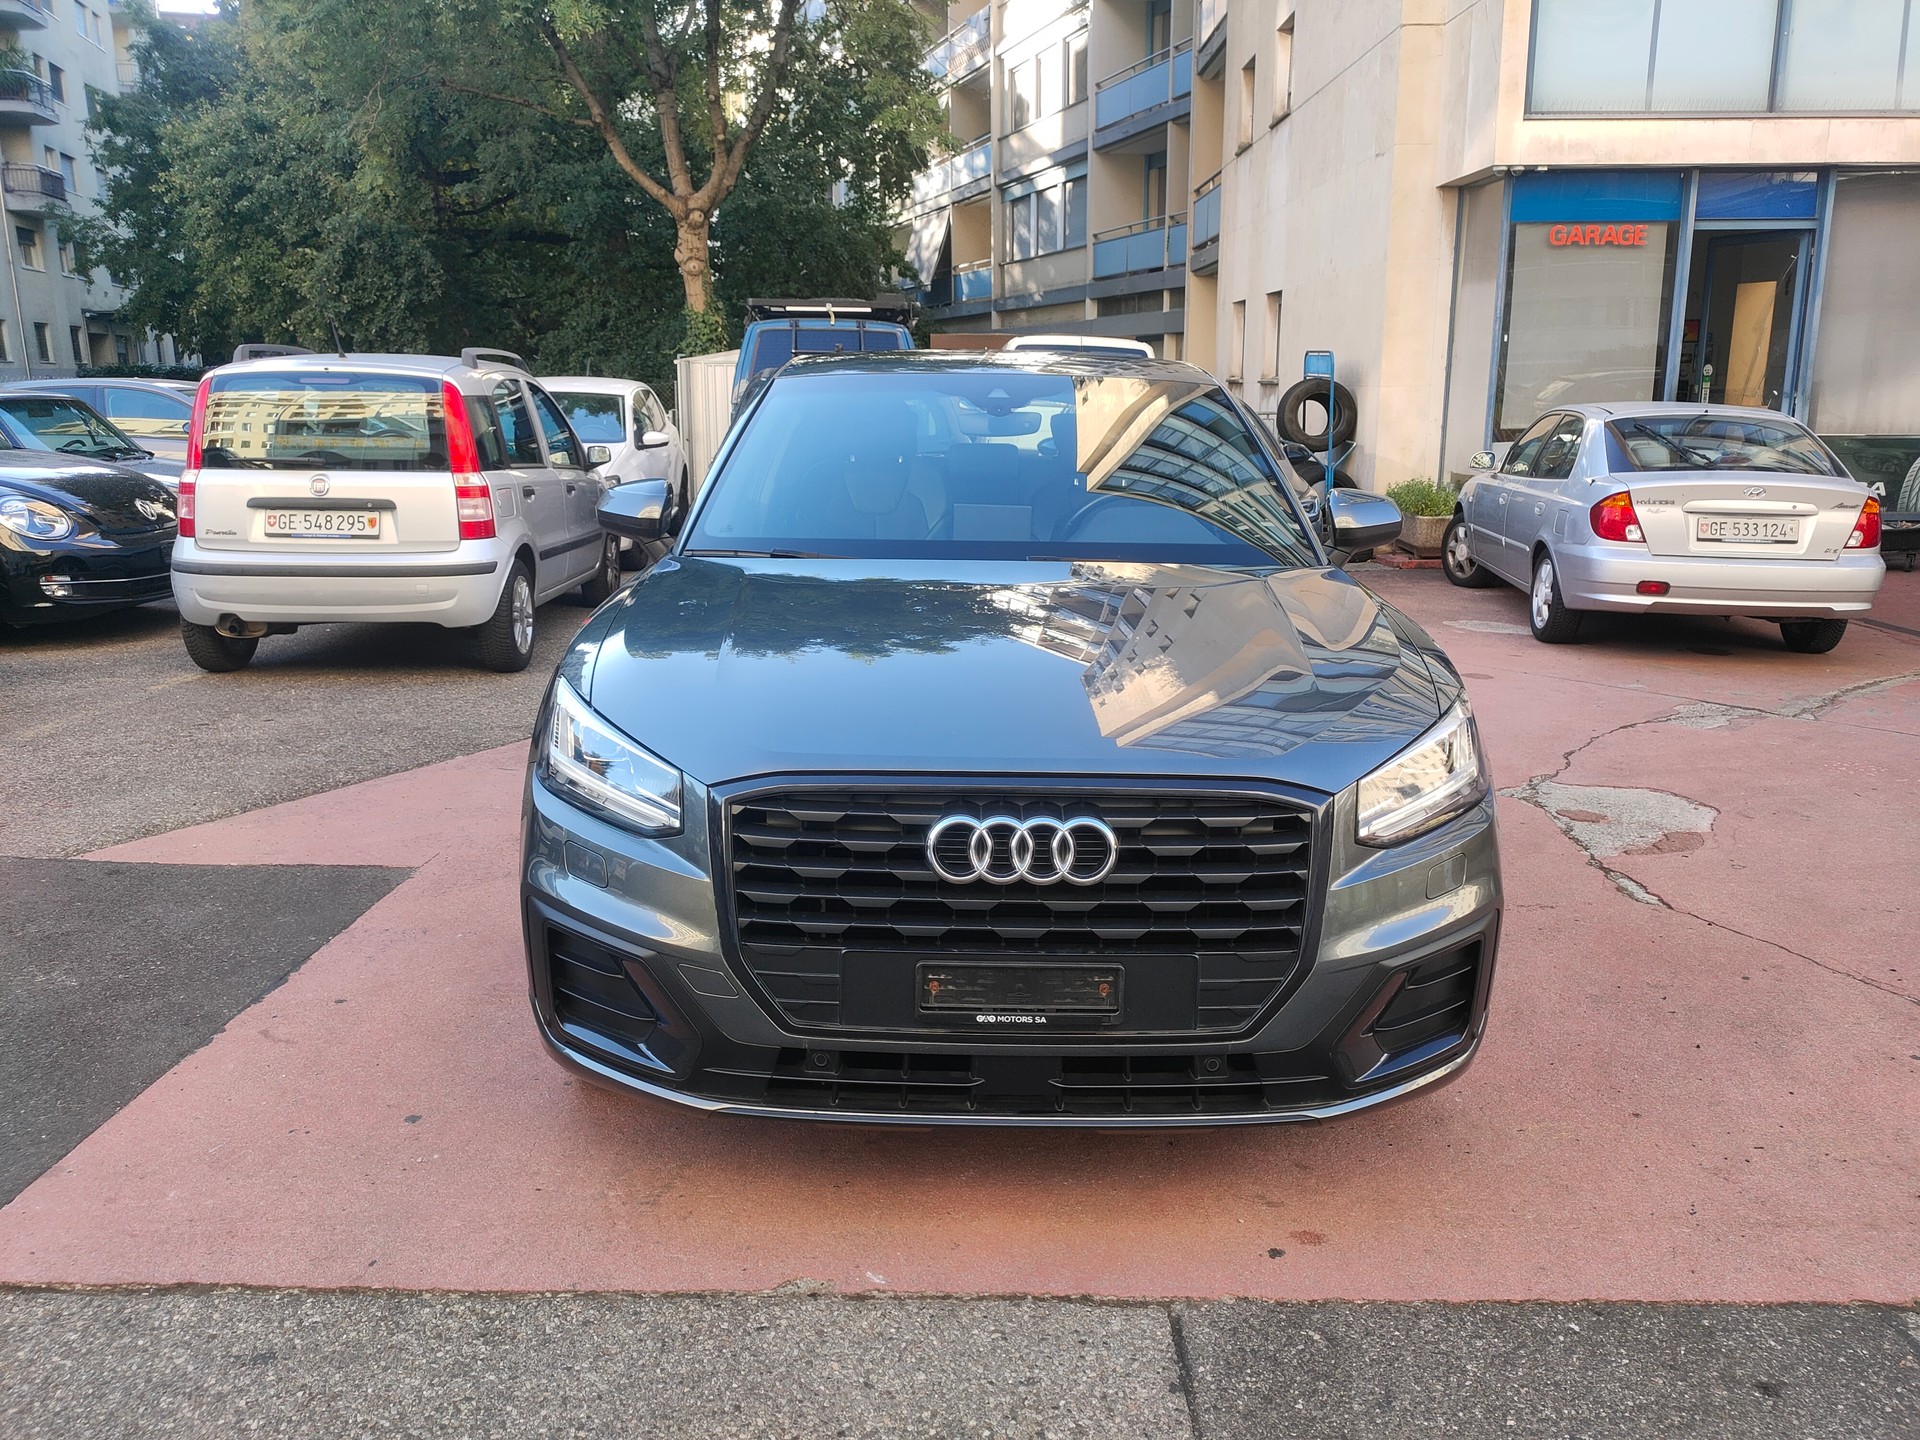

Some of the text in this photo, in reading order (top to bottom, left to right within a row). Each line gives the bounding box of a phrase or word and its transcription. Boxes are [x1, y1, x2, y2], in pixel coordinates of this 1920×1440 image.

[1549, 224, 1649, 246] GARAGE
[997, 1015, 1033, 1023] MOTORS
[1034, 1016, 1047, 1024] SA
